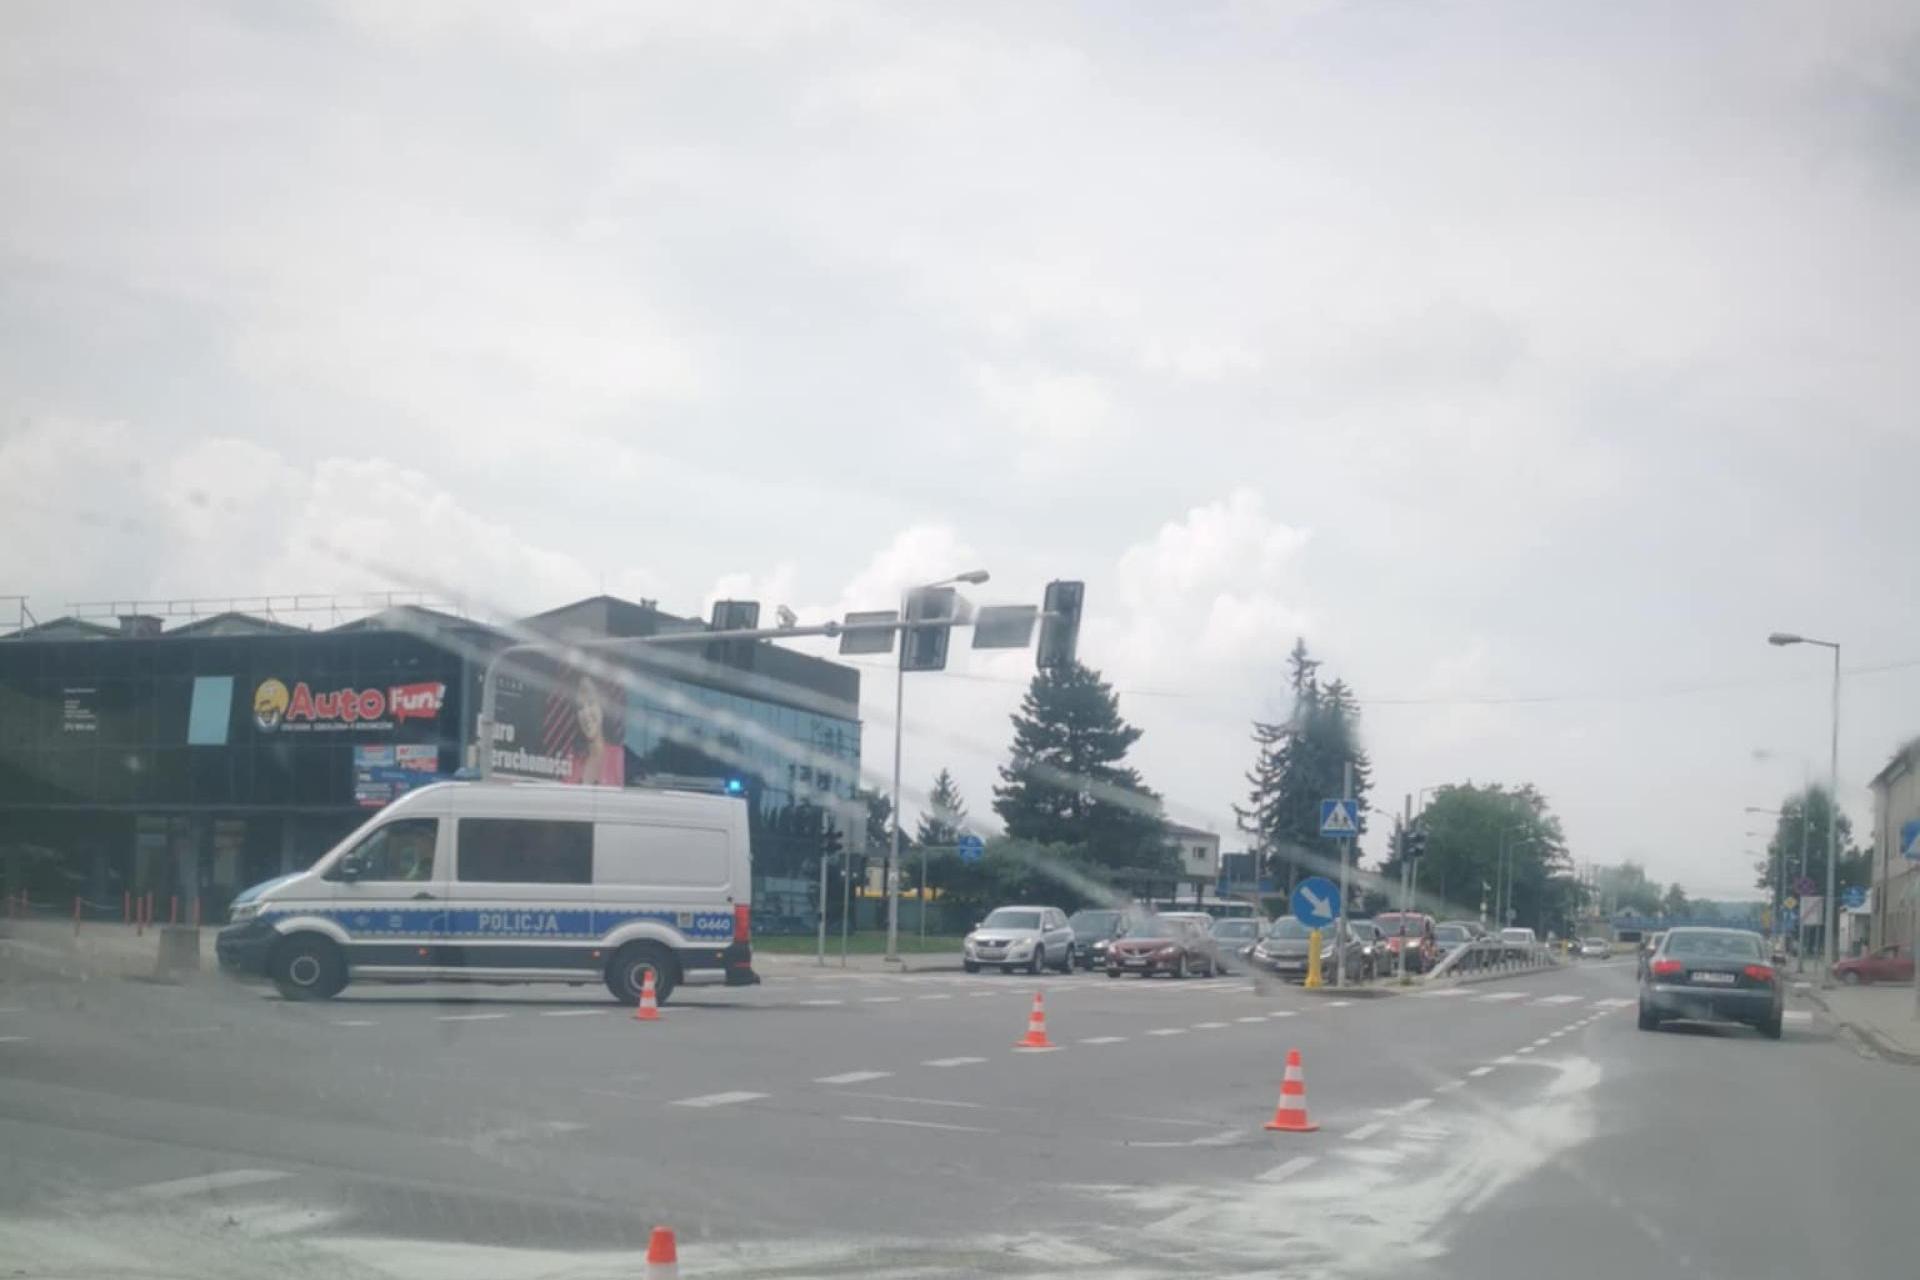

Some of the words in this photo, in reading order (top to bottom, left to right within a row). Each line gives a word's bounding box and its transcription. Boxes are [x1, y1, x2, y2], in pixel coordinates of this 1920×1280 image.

[286, 682, 385, 721] Auto
[390, 684, 446, 713] Fun!
[479, 912, 560, 931] POLICJA
